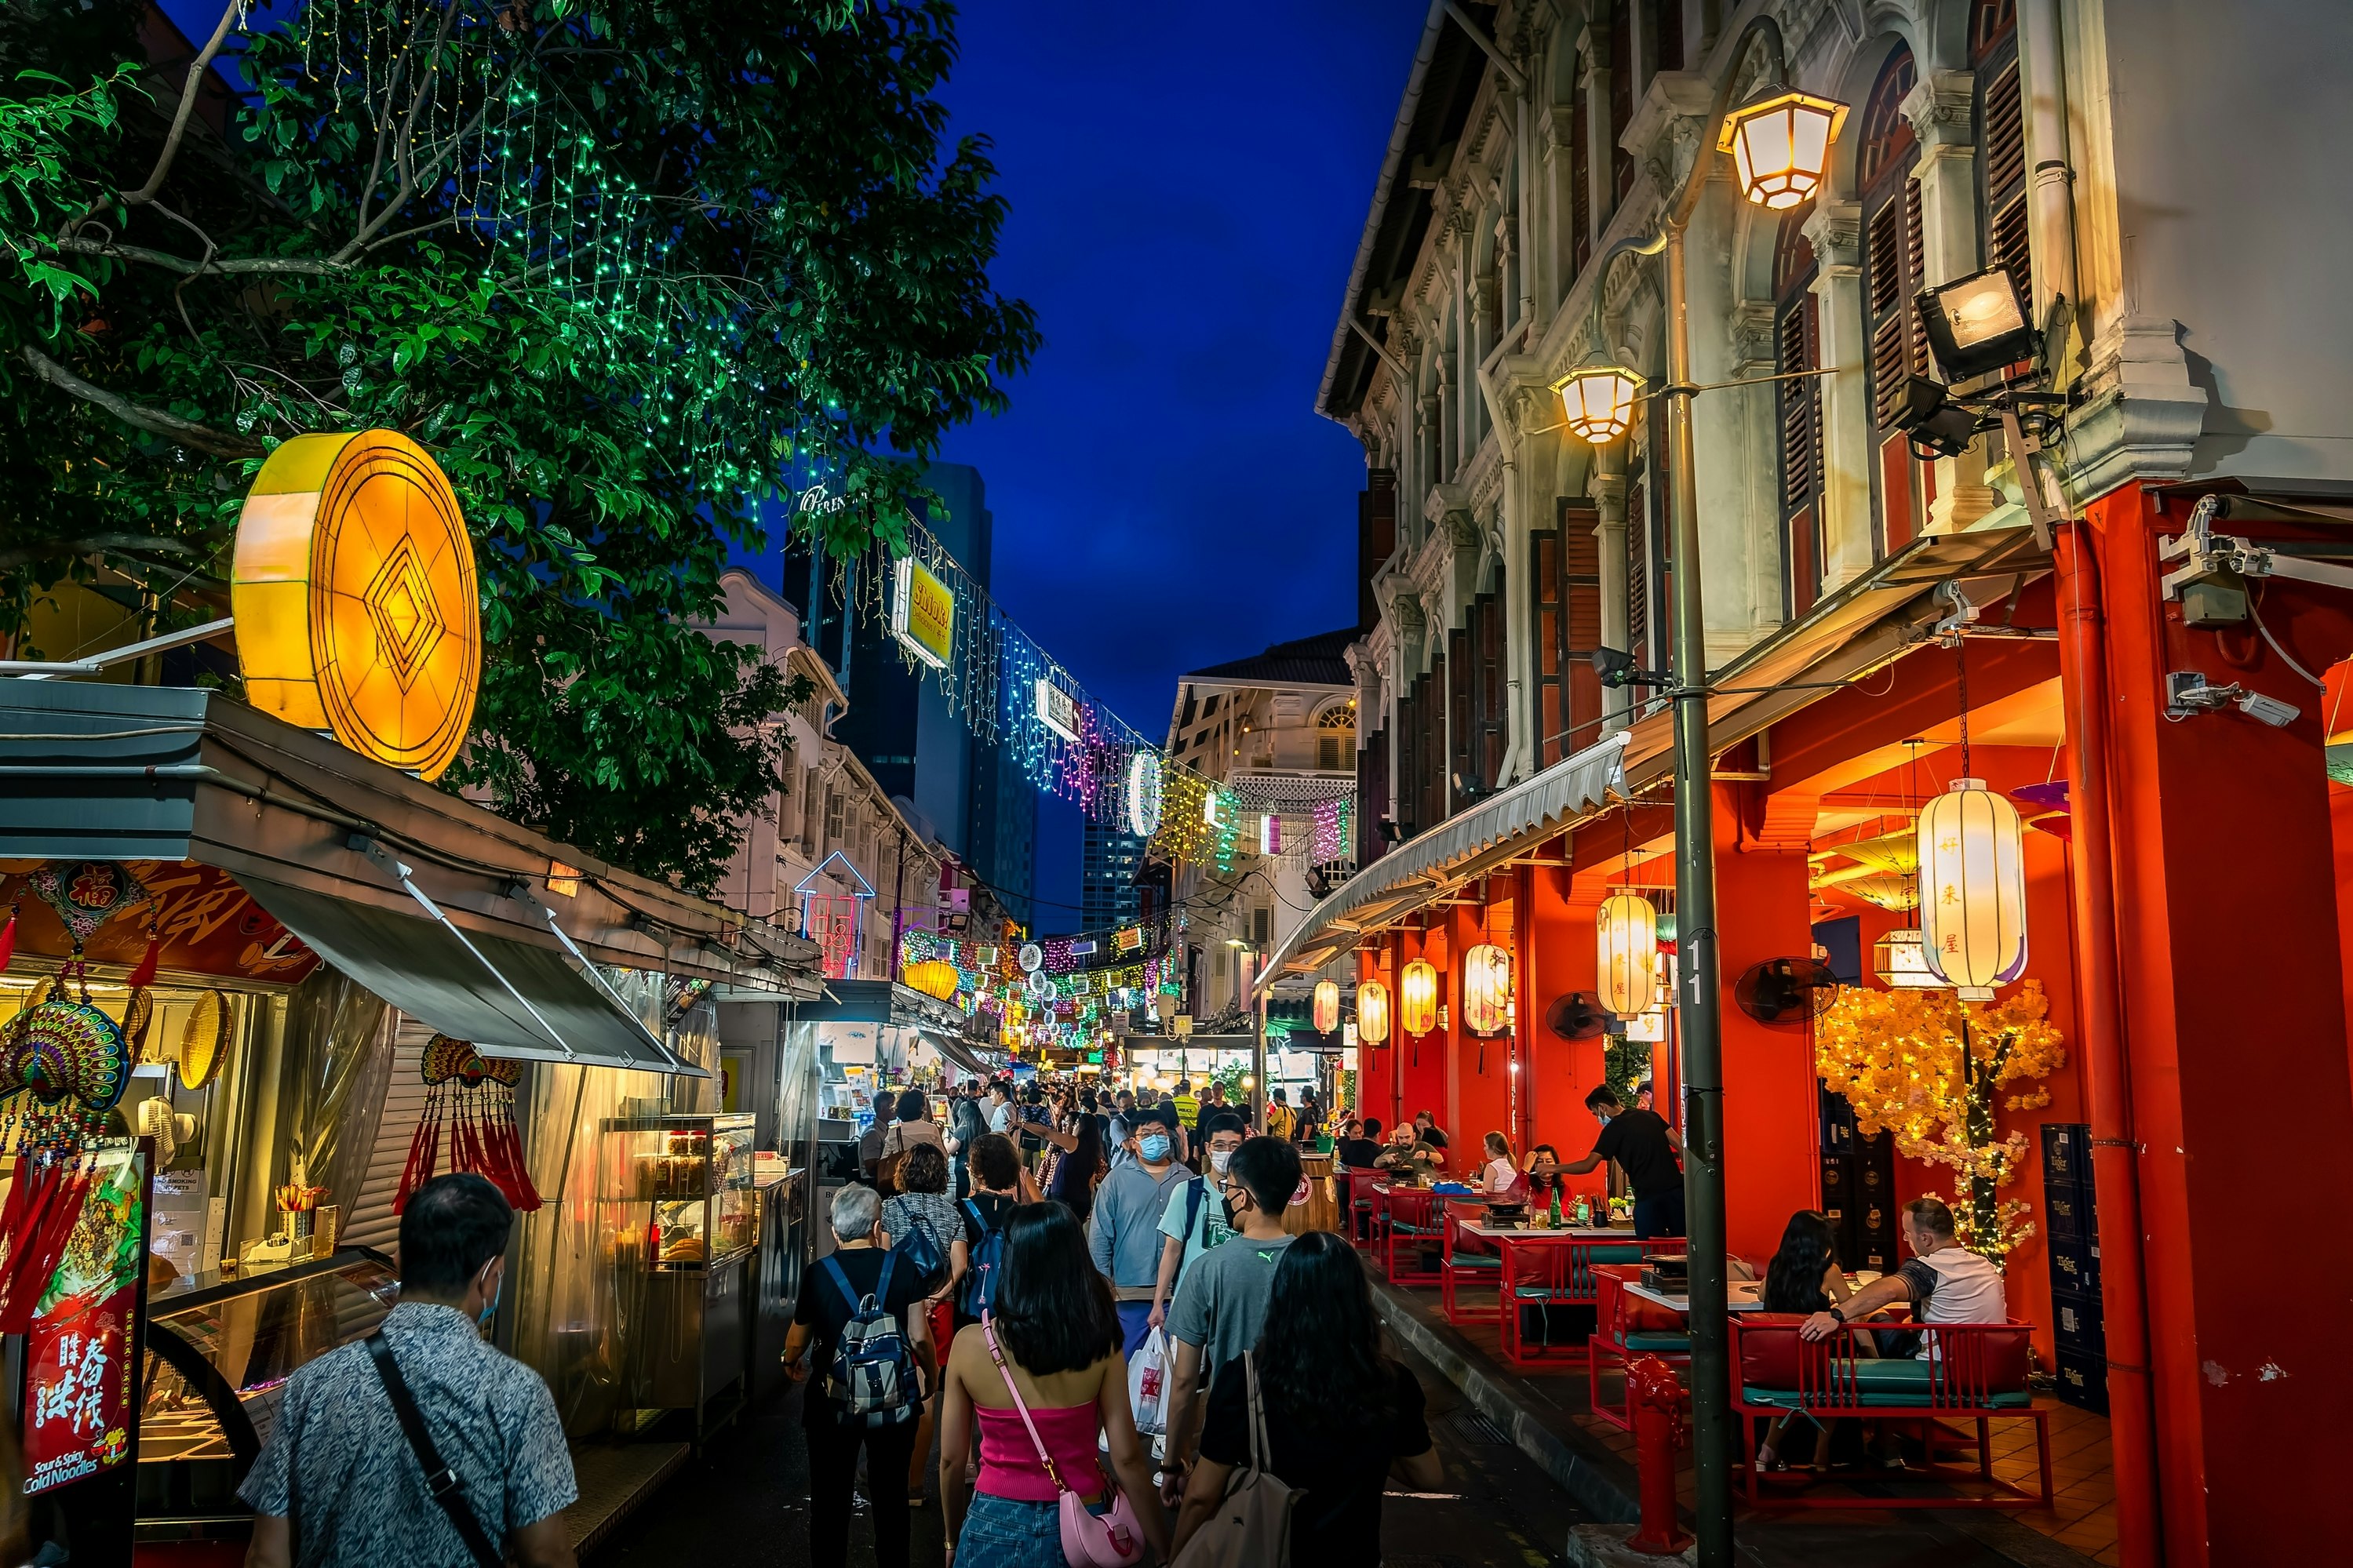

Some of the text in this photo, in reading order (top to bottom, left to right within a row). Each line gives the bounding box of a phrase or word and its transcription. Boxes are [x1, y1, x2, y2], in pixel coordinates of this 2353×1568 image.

[914, 580, 950, 631] Shiok!
[69, 863, 118, 908] 福
[1938, 836, 1961, 954] 好来屋
[2053, 1200, 2071, 1213] Tiger
[2056, 1255, 2075, 1271] Tiger
[23, 1459, 97, 1493] Cold Noodles
[35, 1450, 85, 1475] Sour & Spicy
